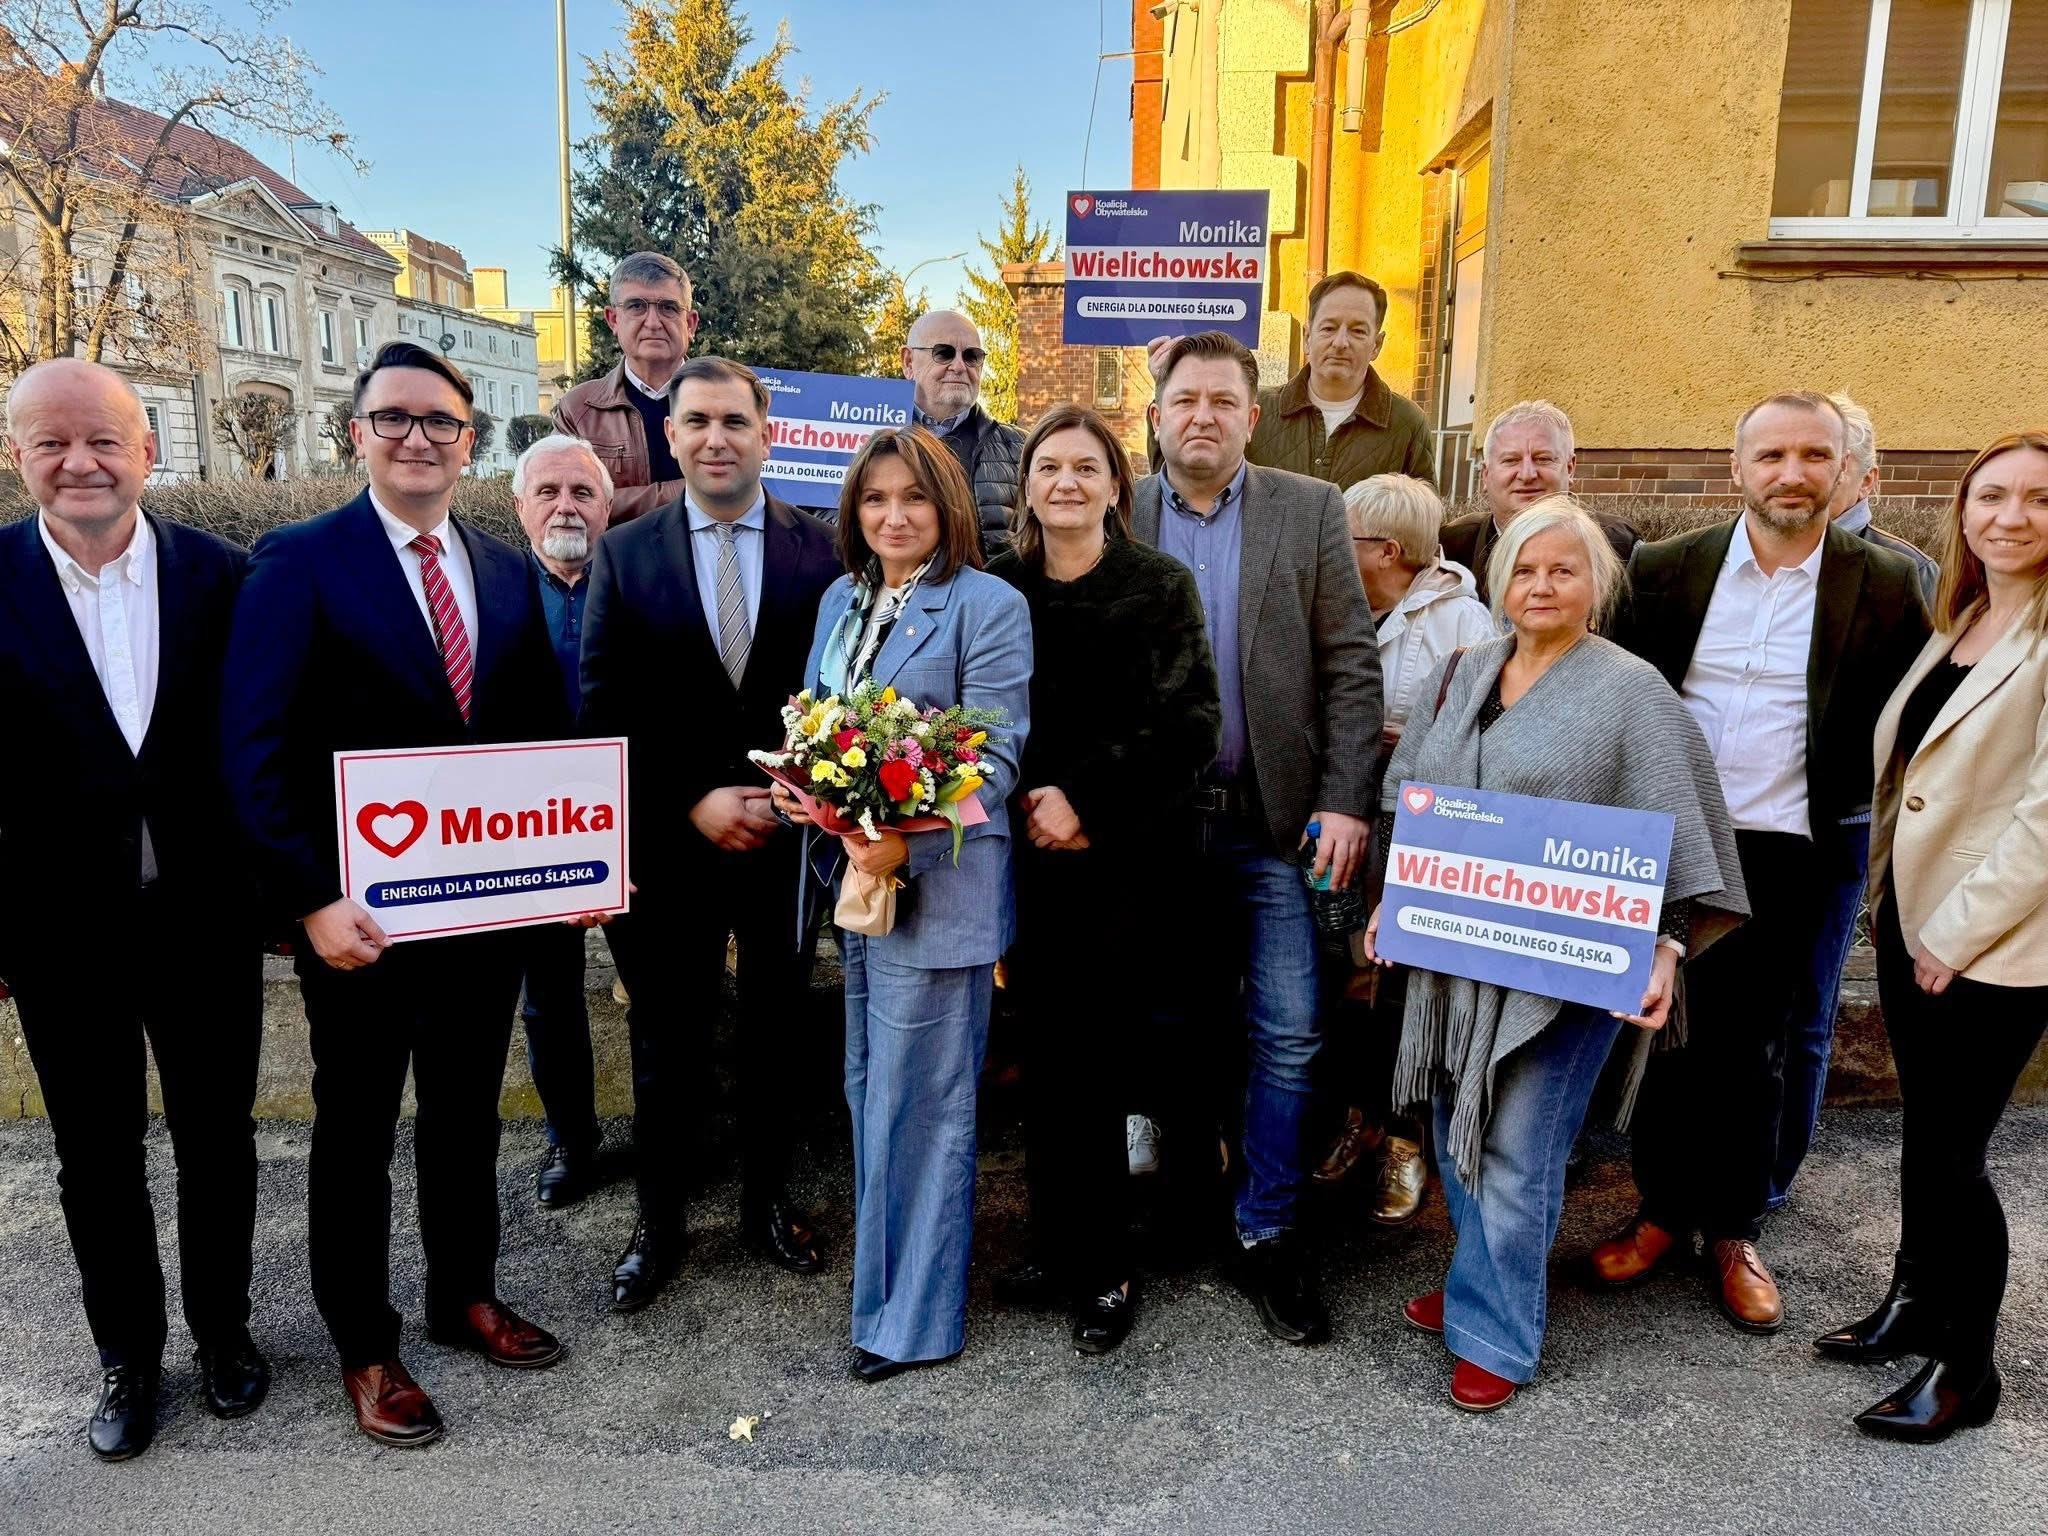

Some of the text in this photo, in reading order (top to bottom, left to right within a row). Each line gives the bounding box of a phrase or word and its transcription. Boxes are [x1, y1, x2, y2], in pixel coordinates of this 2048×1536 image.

[1094, 208, 1148, 218] Obywatelska
[1095, 199, 1128, 210] Koalicja
[1178, 220, 1261, 244] Monika
[1071, 250, 1259, 279] Wielichowska
[1086, 301, 1235, 317] ENERGIA DLA DOLNEGO ŚLĄSKA
[830, 401, 907, 425] Monika
[776, 466, 795, 475] DLA
[797, 467, 843, 479] DOLNEGO
[1433, 804, 1504, 825] Obywatelska
[1434, 796, 1478, 813] Koalicja
[440, 797, 614, 846] Monika
[1542, 837, 1658, 880] Monika
[381, 867, 594, 901] ENERGIA DLA DOLNEGO ŚLĄSKA
[1397, 852, 1651, 926] Wielichowska
[1410, 913, 1613, 965] ENERGIA DLA DOLNEGO ŚLĄSKA
